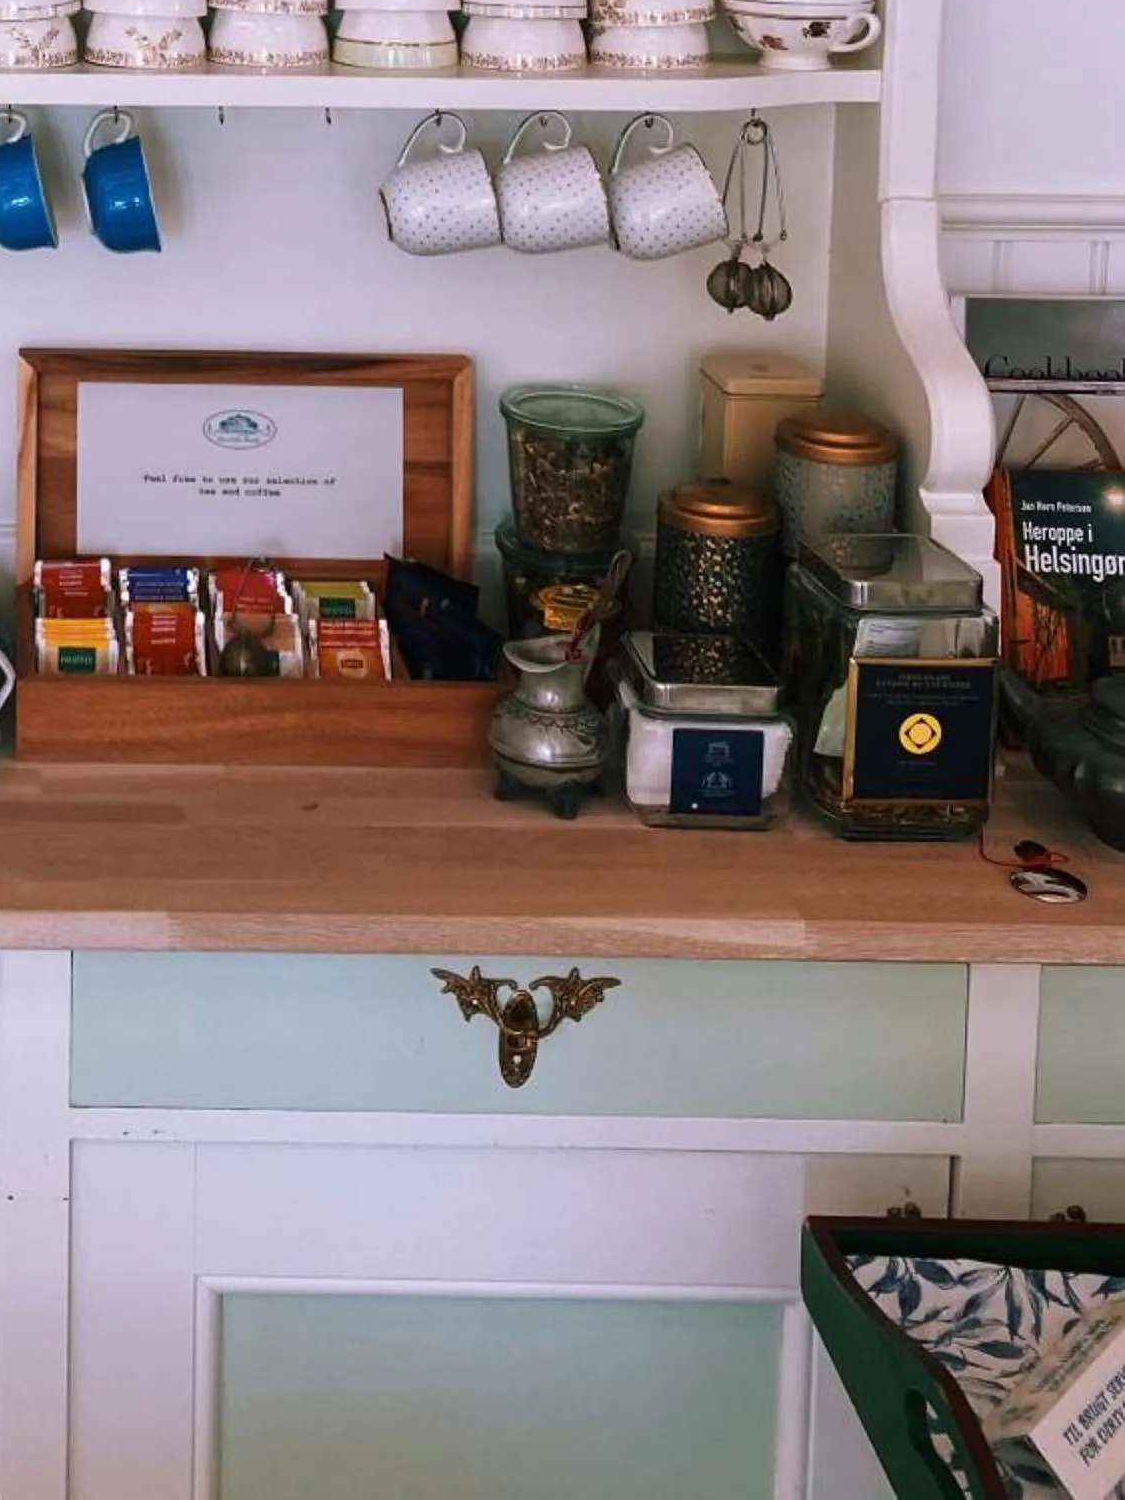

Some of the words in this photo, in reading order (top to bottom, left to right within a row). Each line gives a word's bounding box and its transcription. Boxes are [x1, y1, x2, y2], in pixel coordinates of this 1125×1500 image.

[984, 355, 1125, 381] Cookboo
[142, 472, 167, 484] Feel
[171, 472, 197, 484] free
[201, 475, 215, 484] to
[218, 476, 238, 485] use
[265, 474, 319, 486] selection
[323, 475, 337, 487] of
[198, 486, 217, 496] tea
[221, 486, 241, 497] and
[243, 486, 282, 497] coffee
[1020, 499, 1035, 512] Jan
[1056, 501, 1092, 513] Petersen
[1021, 520, 1085, 548] Heroppe
[1087, 522, 1094, 543] i
[1024, 543, 1125, 584] Helsingør
[1078, 1436, 1104, 1469] FOR
